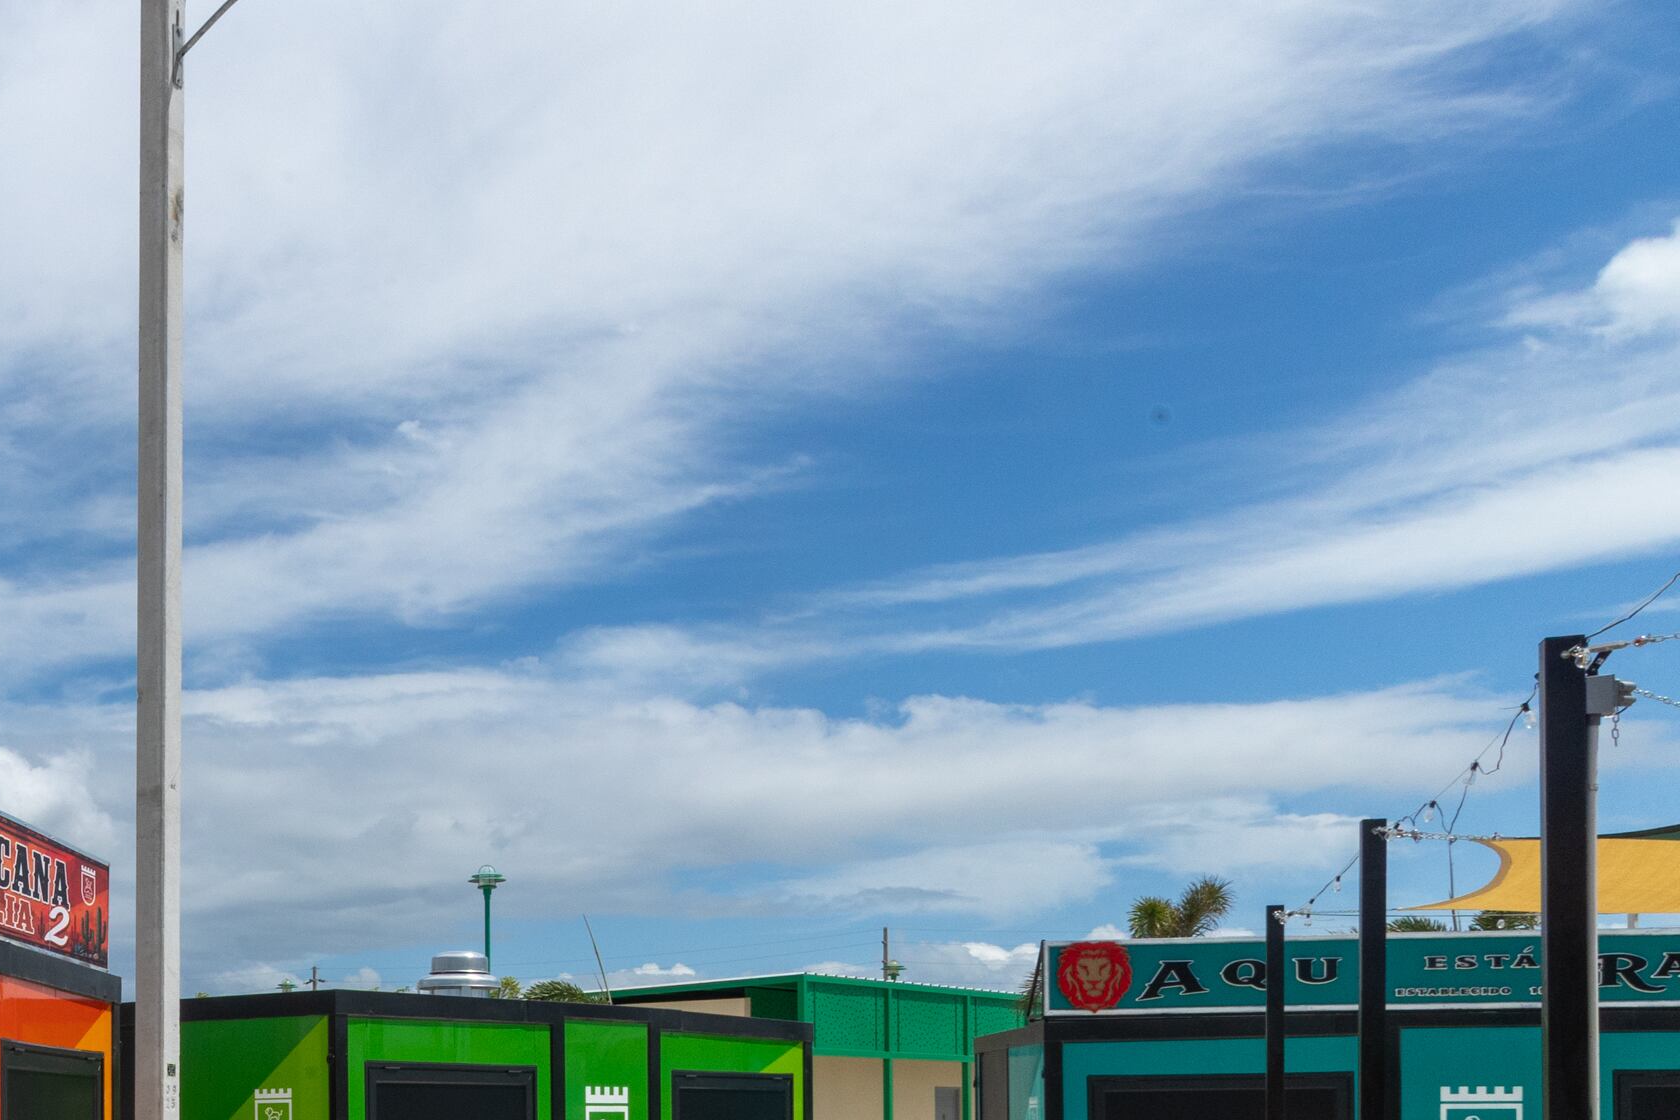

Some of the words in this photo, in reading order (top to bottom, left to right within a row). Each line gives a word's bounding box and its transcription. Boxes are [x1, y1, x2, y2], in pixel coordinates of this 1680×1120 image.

[44, 906, 70, 946] 2
[1424, 945, 1541, 970] ESTÁ
[1135, 957, 1344, 1002] AQU
[1394, 986, 1512, 997] ESTABLECIDO
